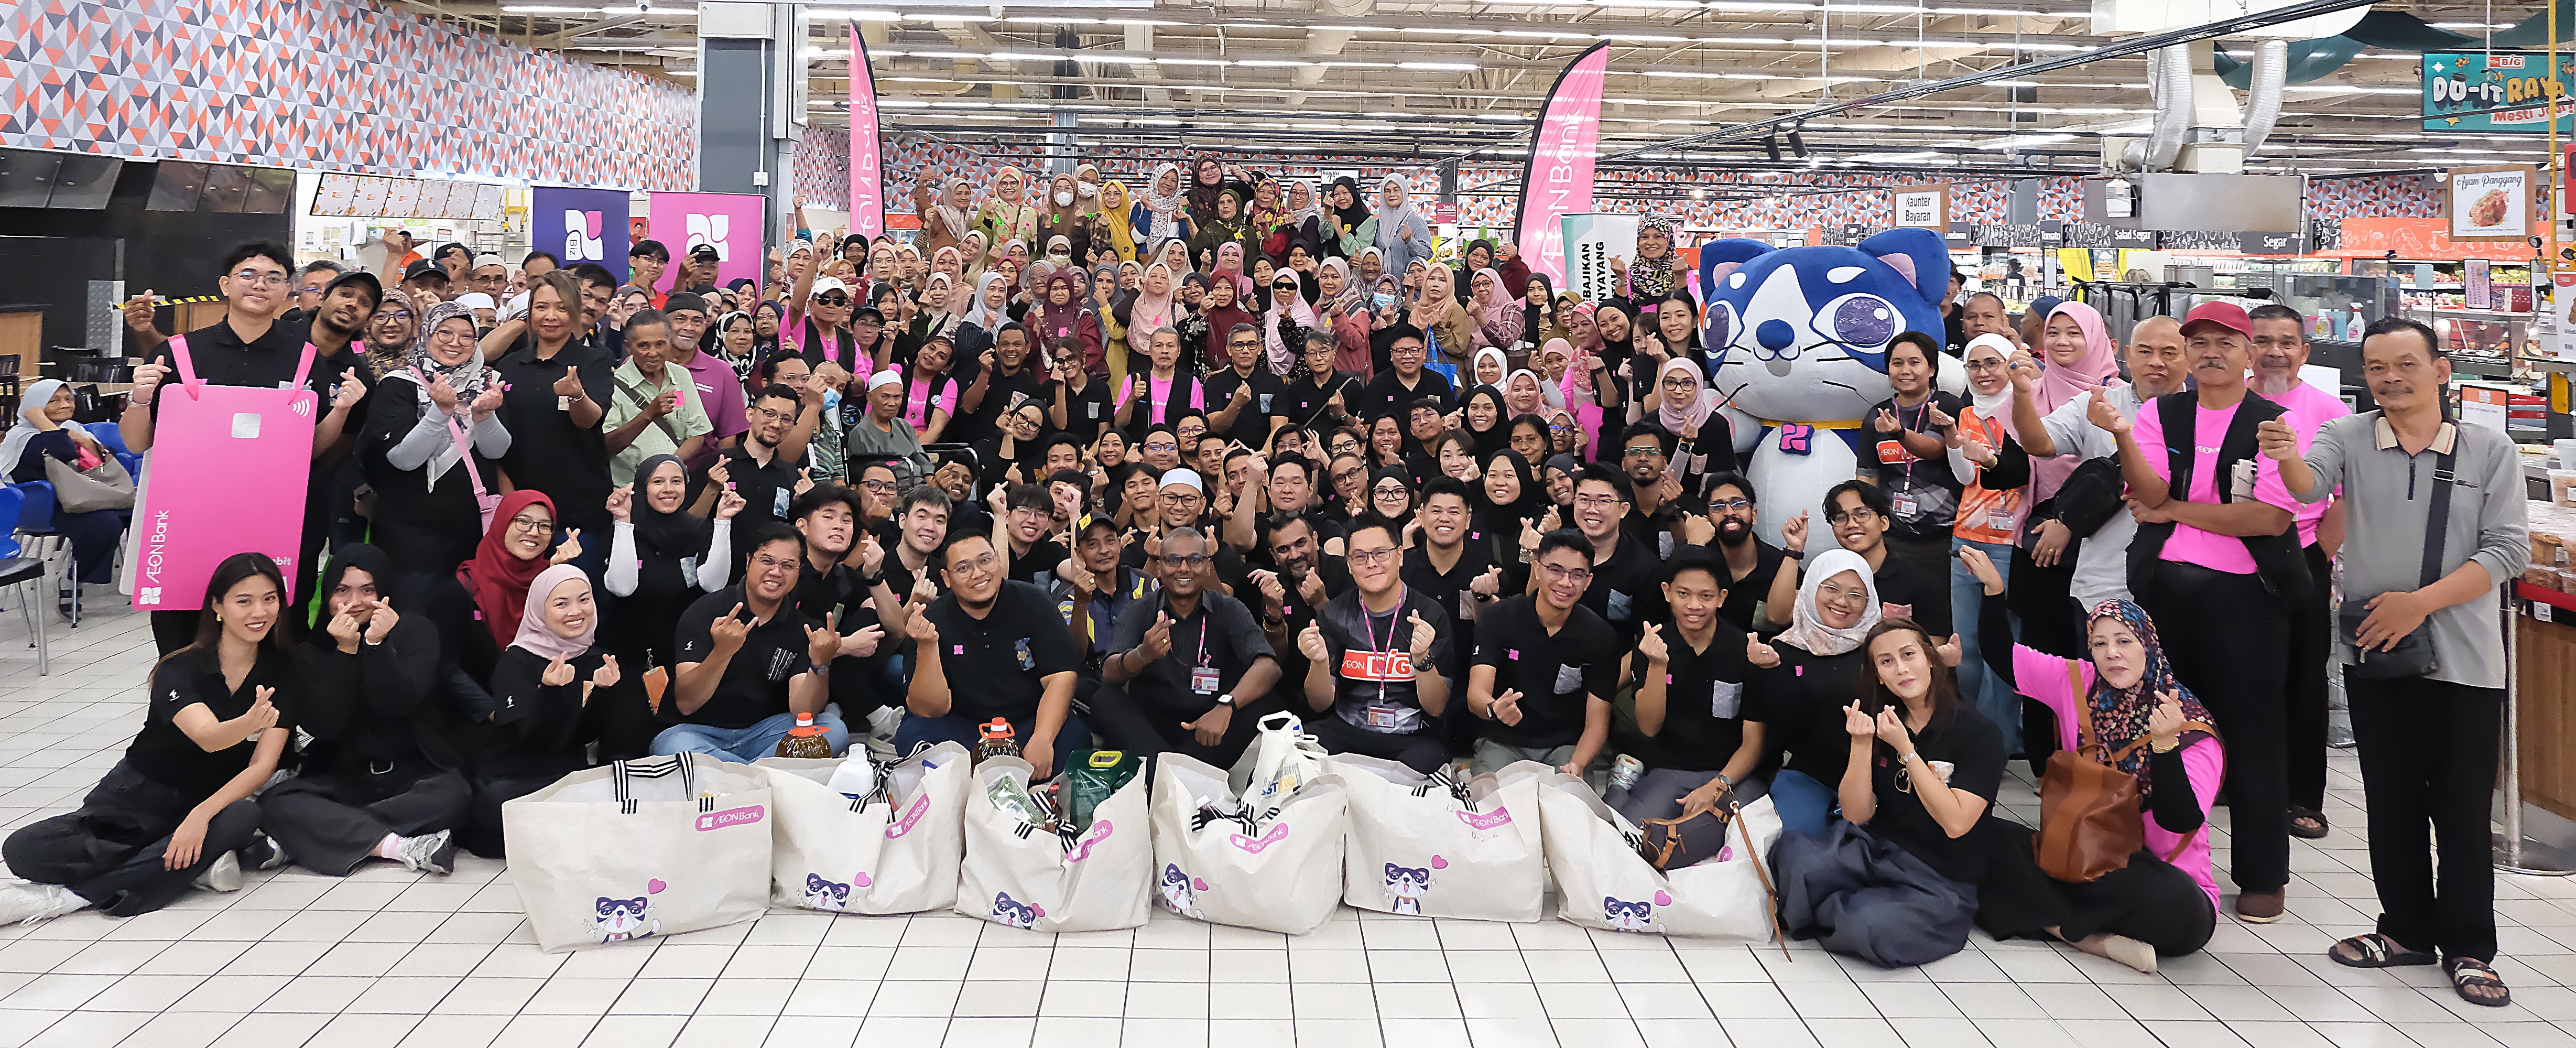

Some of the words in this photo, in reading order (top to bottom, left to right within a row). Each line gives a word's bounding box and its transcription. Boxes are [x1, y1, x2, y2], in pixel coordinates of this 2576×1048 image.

[2494, 109, 2533, 121] Mesti
[1906, 196, 1931, 207] Kaunter
[1906, 210, 1931, 224] Bayaran
[2115, 229, 2132, 240] Salad
[2263, 235, 2288, 250] Segar
[1082, 518, 1088, 526] 2
